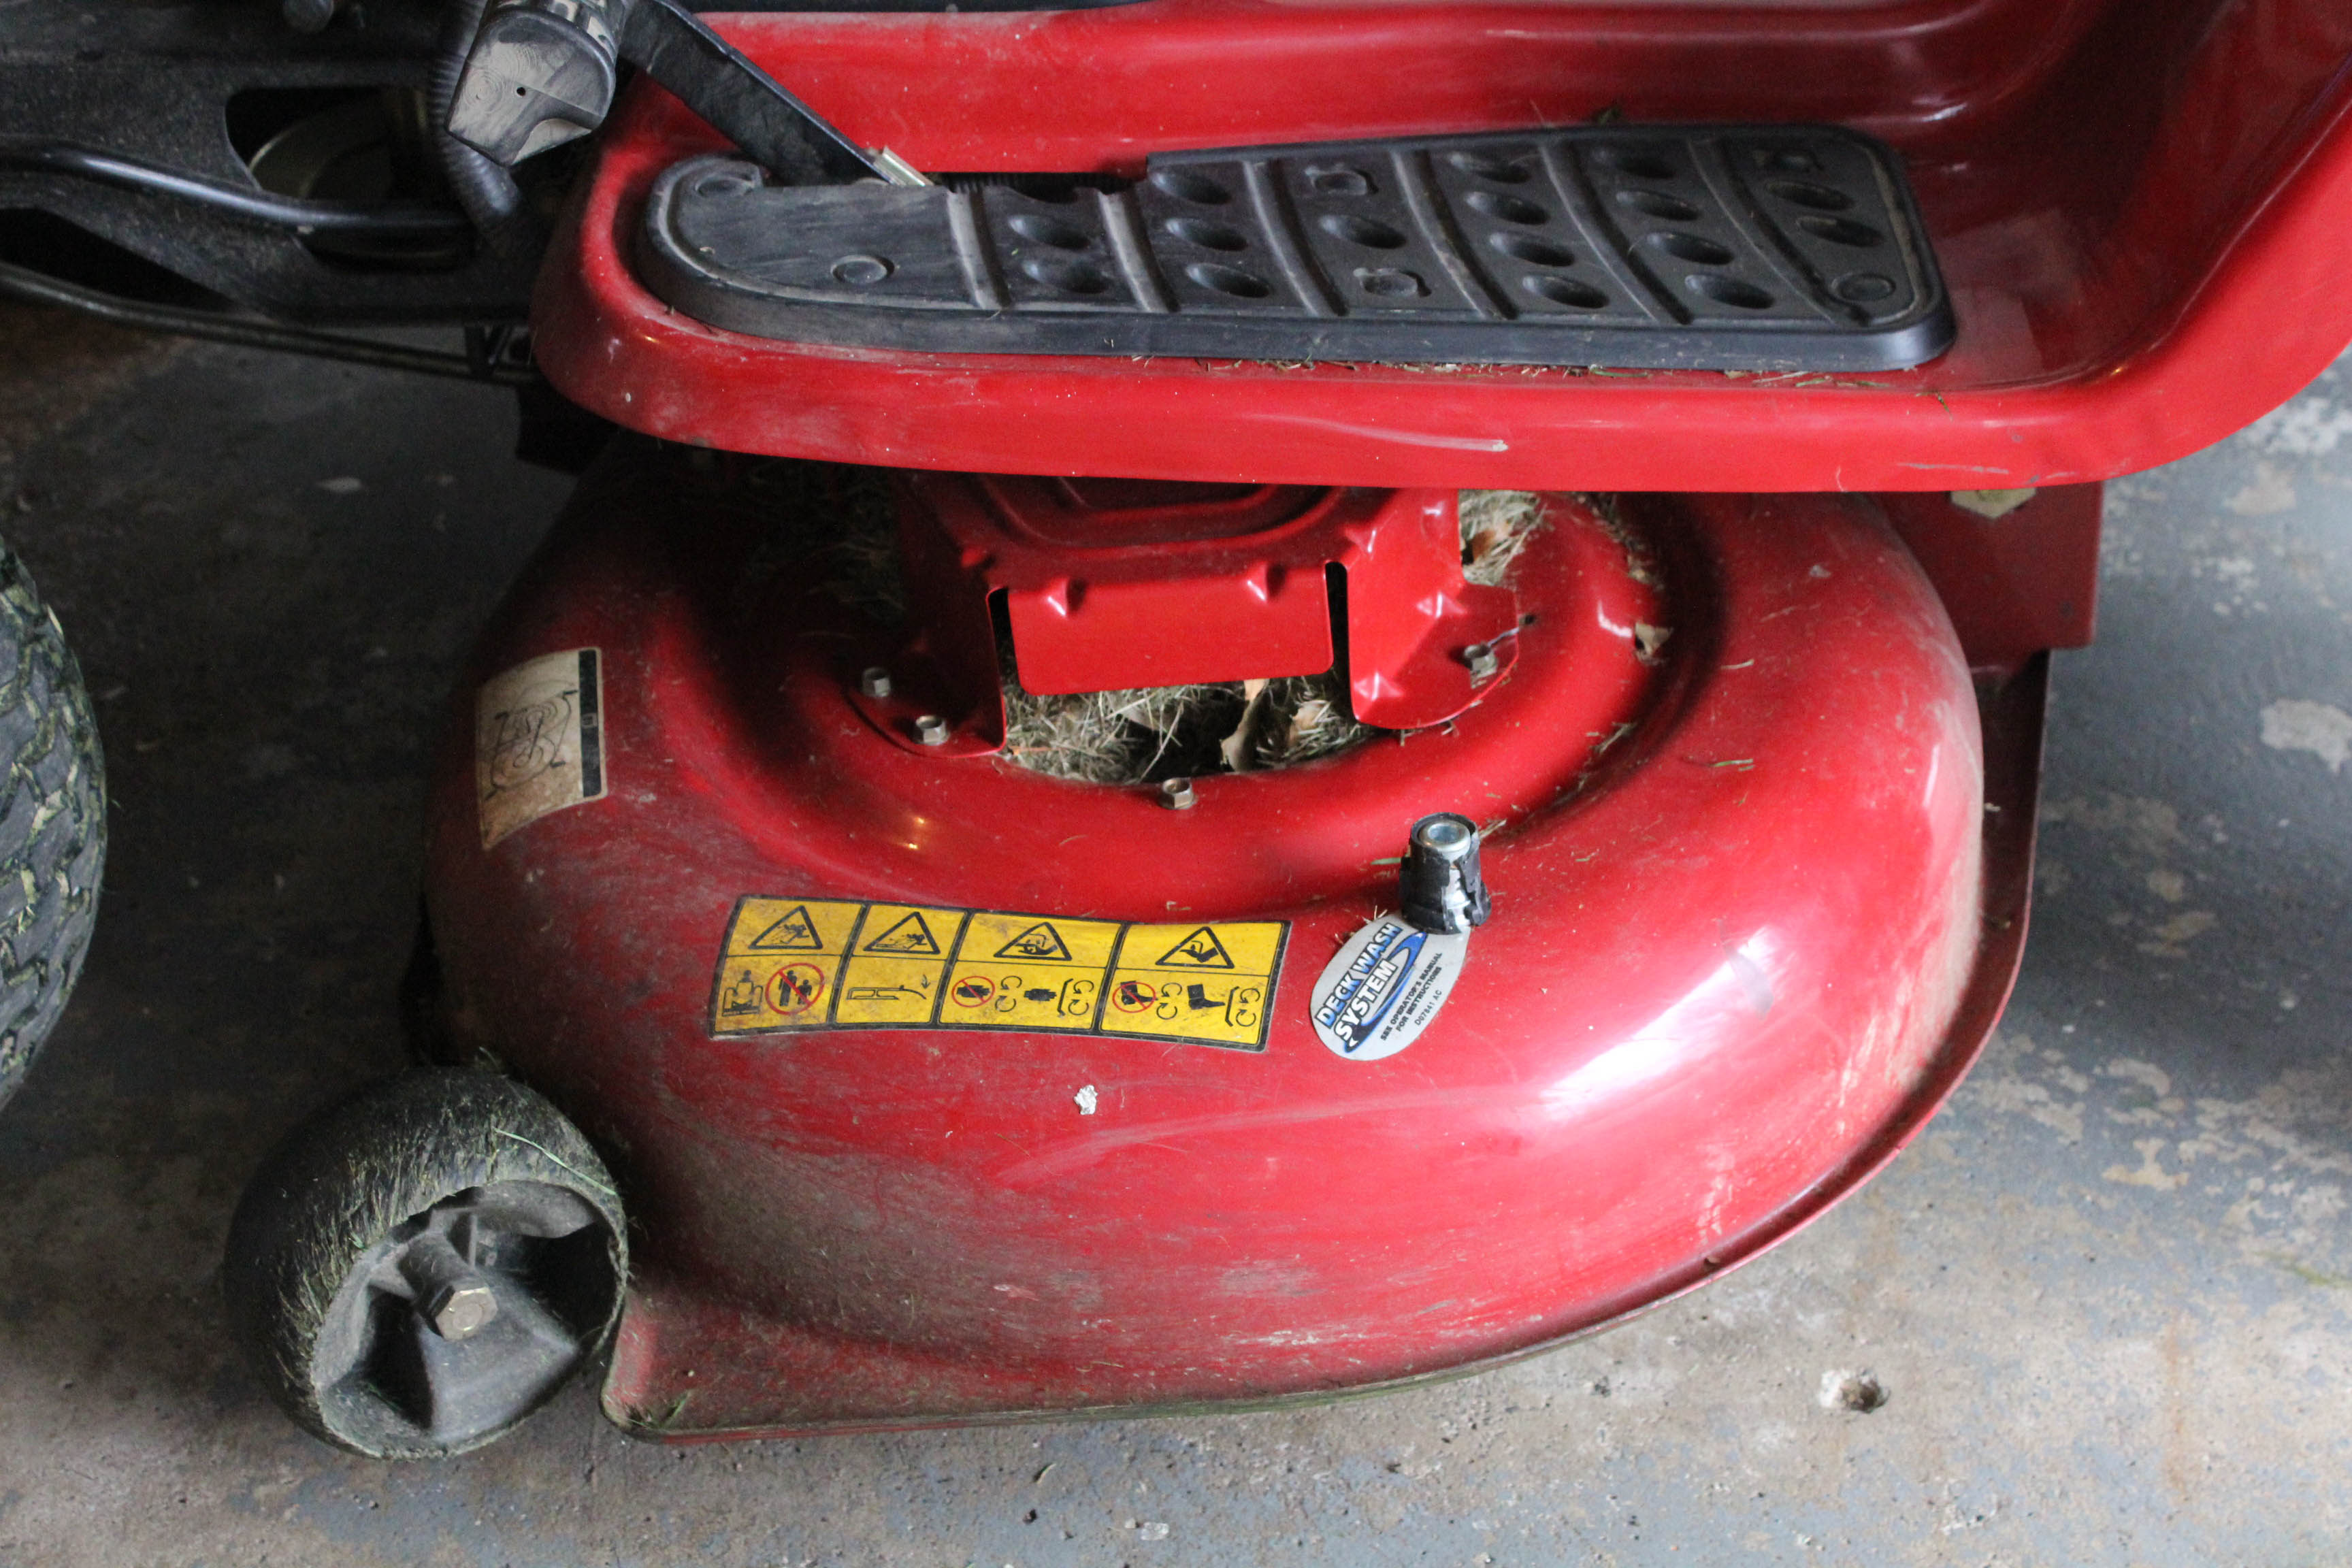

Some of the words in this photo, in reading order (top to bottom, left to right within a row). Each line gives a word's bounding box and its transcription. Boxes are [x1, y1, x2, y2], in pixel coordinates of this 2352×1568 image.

[1315, 971, 1363, 1029] DECK
[1350, 922, 1403, 974] WASH
[1334, 959, 1398, 1041] SYSTEM
[1396, 1017, 1409, 1032] FOR
[1407, 967, 1442, 1015] INSTRUCTIONS
[1420, 953, 1442, 983] MANUAL
[1435, 990, 1442, 1000] AC
